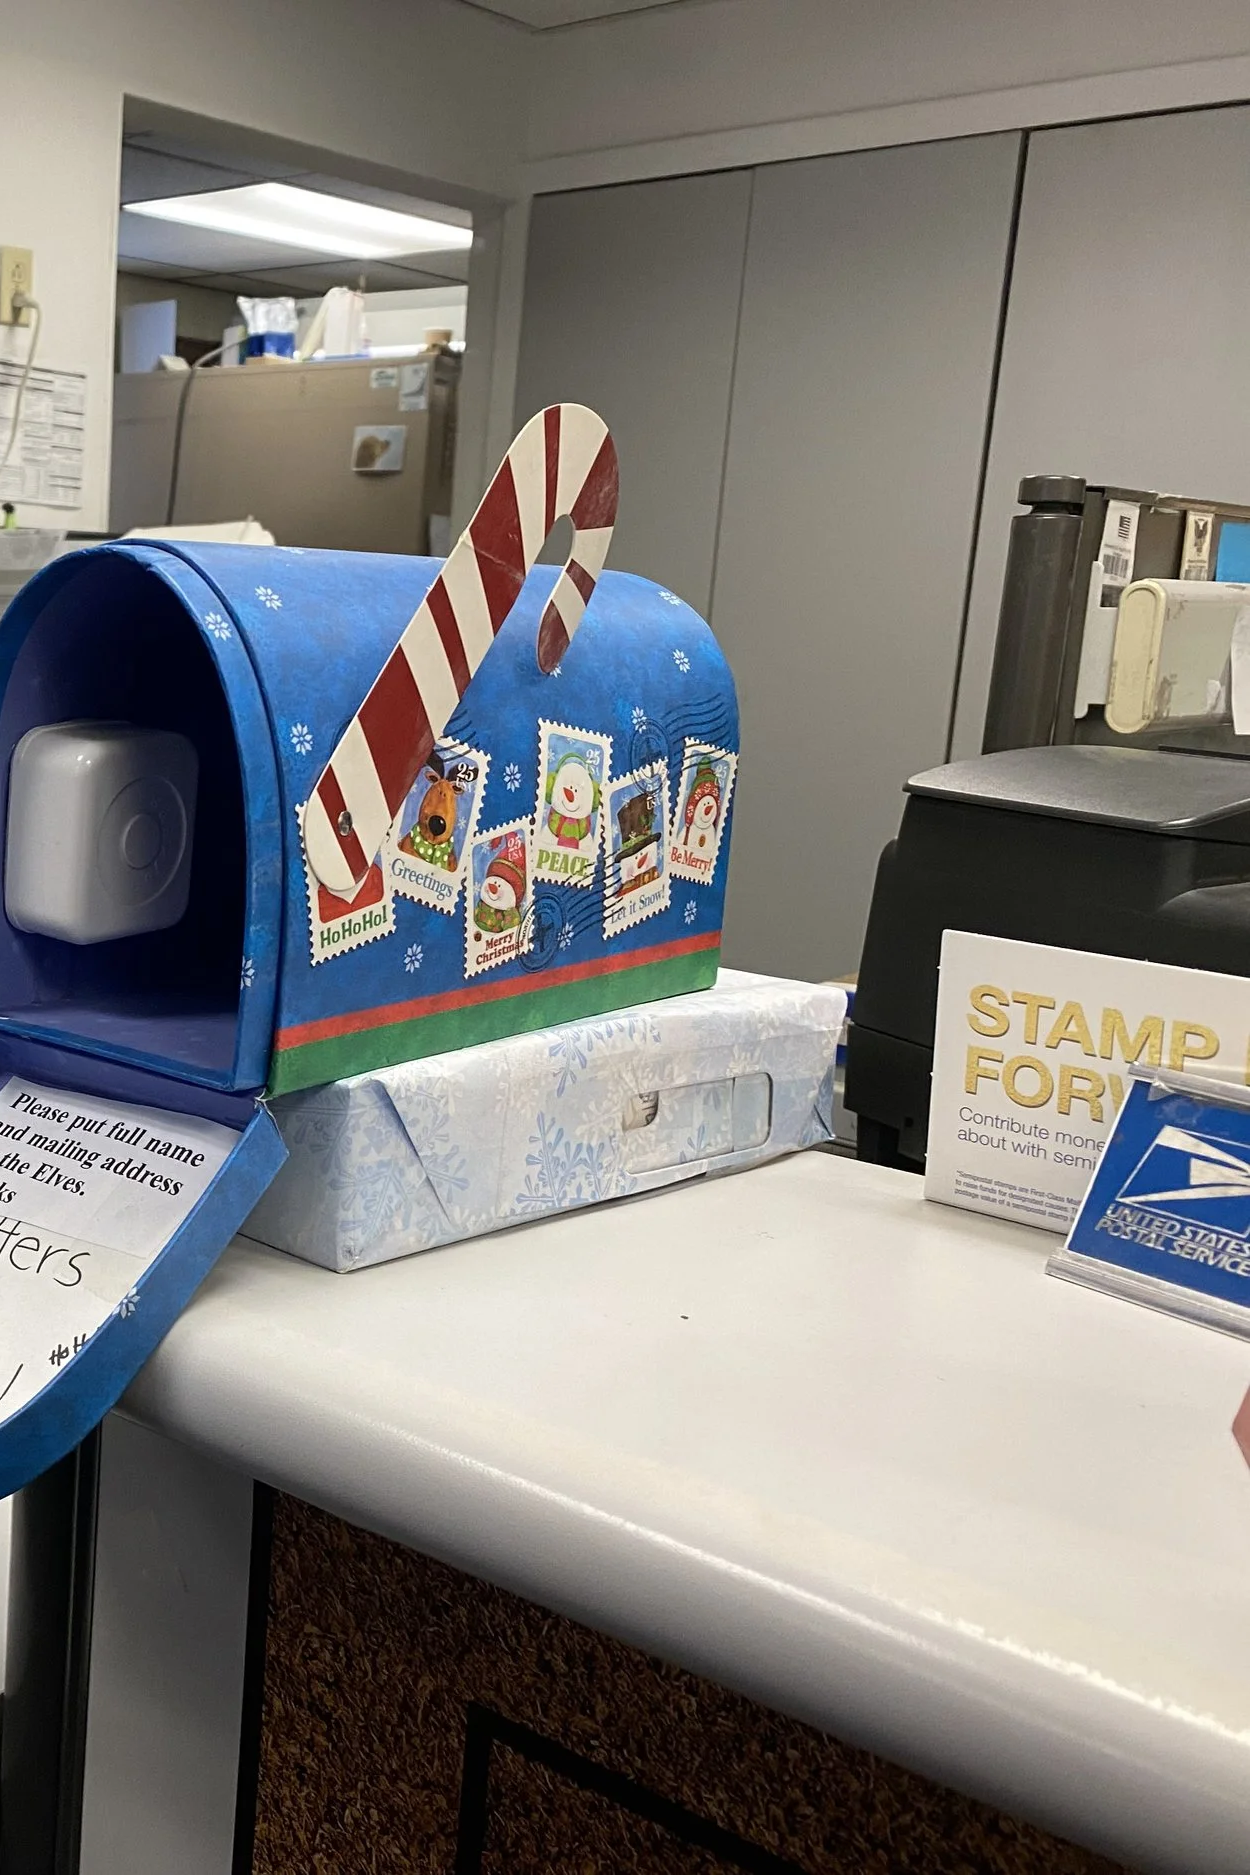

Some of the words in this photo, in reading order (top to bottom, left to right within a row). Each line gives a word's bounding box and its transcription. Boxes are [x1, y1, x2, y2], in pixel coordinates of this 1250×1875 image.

[457, 762, 475, 782] 25
[535, 849, 590, 877] PEACE
[671, 846, 682, 864] Be
[681, 849, 713, 875] Merry!
[391, 858, 454, 901] Greetings
[611, 906, 626, 924] Let
[629, 900, 637, 915] it
[639, 883, 665, 910] Snow!
[476, 941, 524, 965] Christmas
[485, 932, 515, 951] Merry
[966, 984, 1220, 1072] STAMP
[9, 1092, 69, 1123] Please
[66, 1114, 107, 1135] put
[105, 1122, 146, 1147] full
[143, 1136, 205, 1168] name
[959, 1106, 1049, 1140] Contribute
[958, 1128, 1007, 1151] about
[1012, 1141, 1047, 1160] with
[27, 1134, 101, 1170] mailing
[100, 1156, 184, 1196] address
[30, 1162, 86, 1196] Elves.
[1094, 1217, 1166, 1251] POSTAL
[1168, 1239, 1250, 1278] SERVICE
[1106, 1203, 1181, 1235] UNITED
[1180, 1226, 1250, 1258] STATES
[73, 1333, 91, 1354] H
